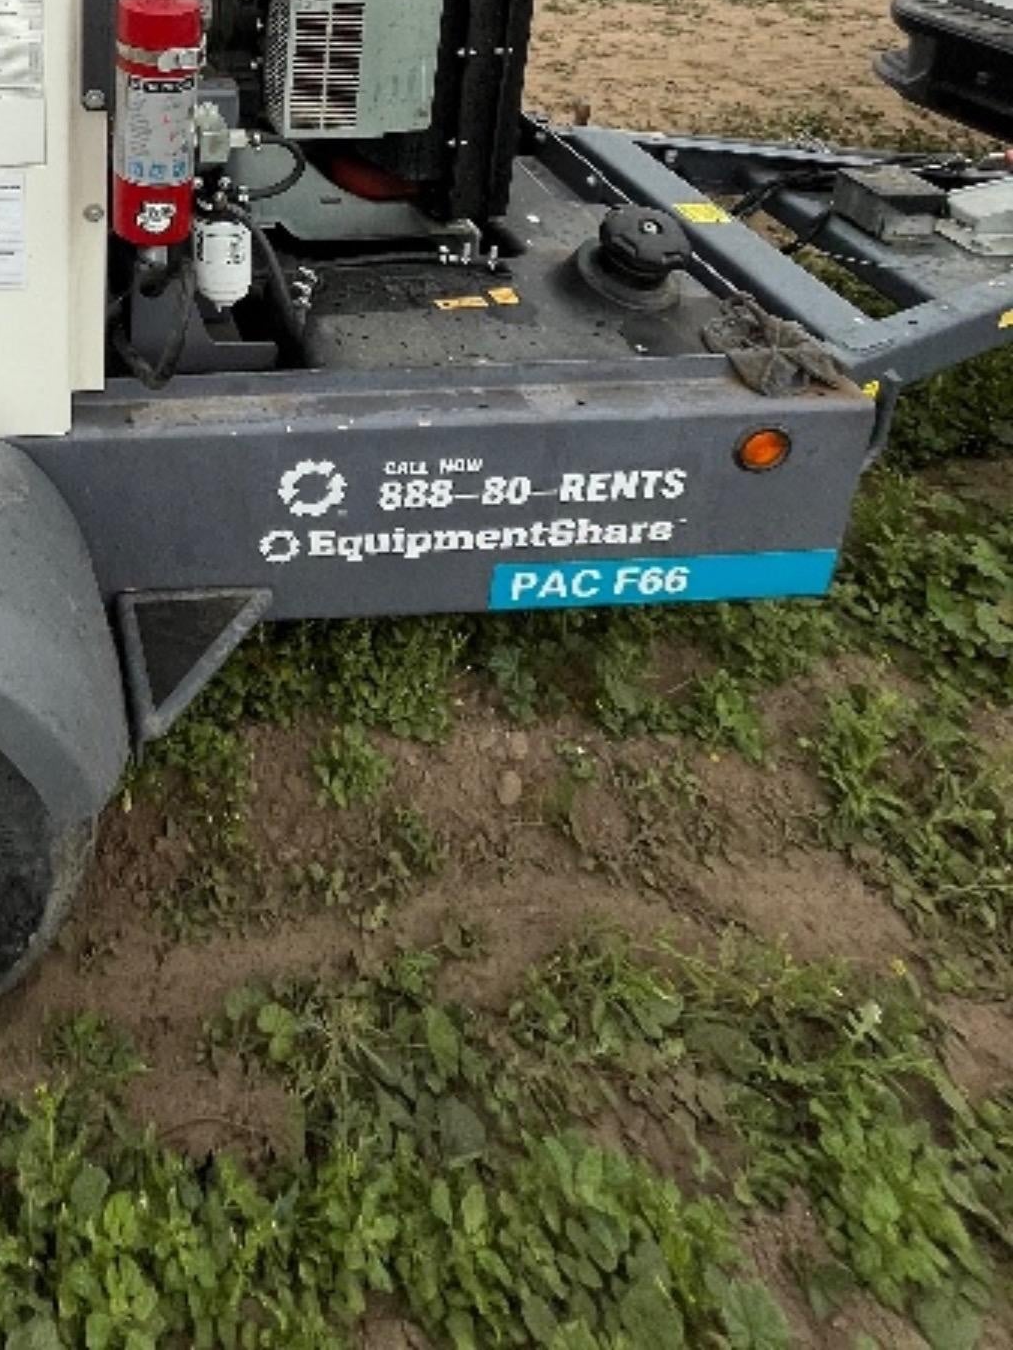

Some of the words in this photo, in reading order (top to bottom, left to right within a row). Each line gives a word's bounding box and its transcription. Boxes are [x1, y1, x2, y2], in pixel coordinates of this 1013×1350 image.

[384, 461, 428, 475] CALL
[439, 458, 484, 473] NOW
[308, 518, 674, 561] EquipmentShare
[511, 569, 601, 601] PAC
[613, 566, 689, 596] F66
